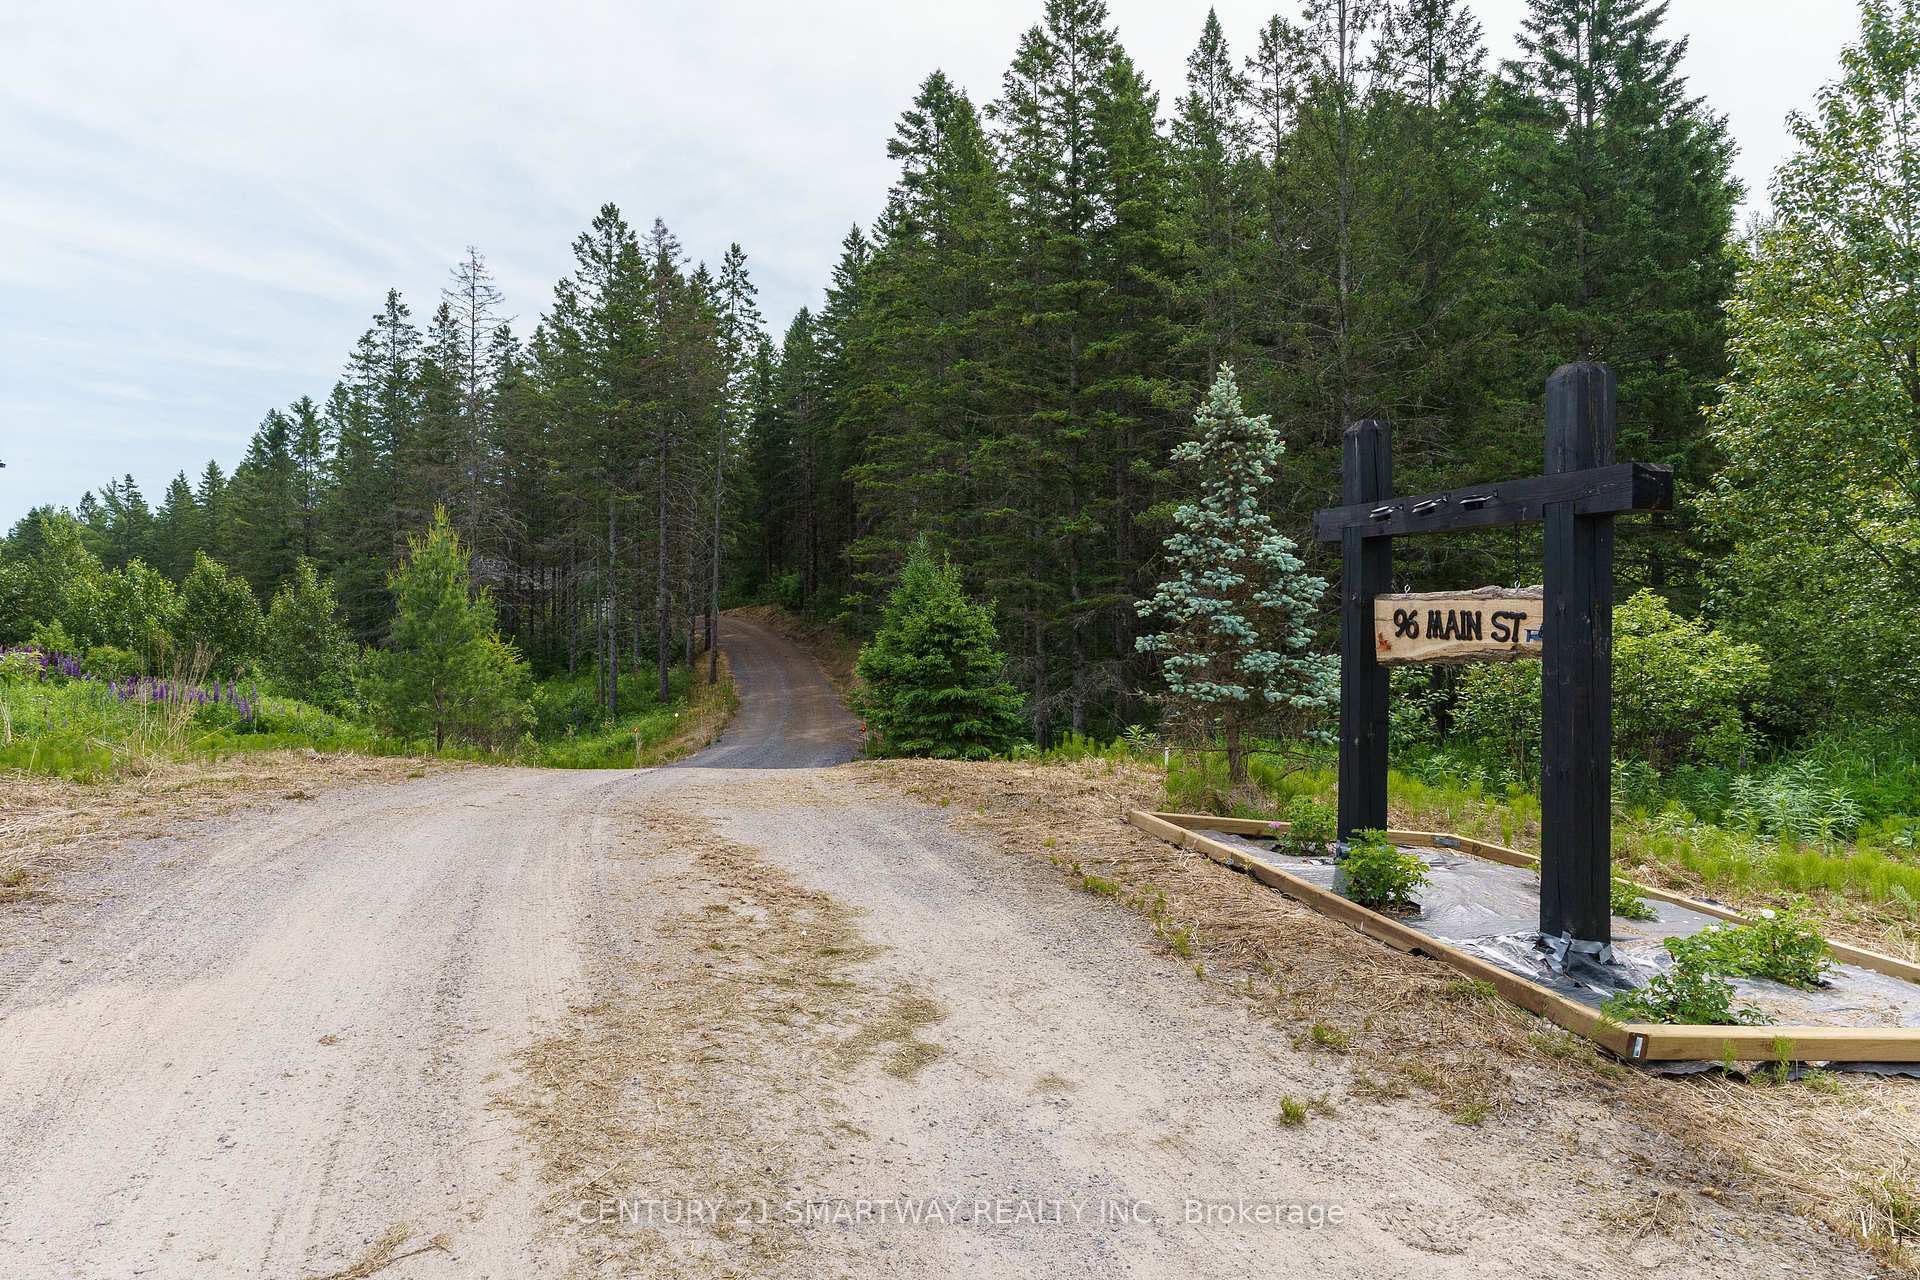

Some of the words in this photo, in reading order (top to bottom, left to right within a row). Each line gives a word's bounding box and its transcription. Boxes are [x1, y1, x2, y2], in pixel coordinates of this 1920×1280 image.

[1393, 608, 1419, 639] 96
[1425, 609, 1482, 641] MAIN
[1490, 610, 1527, 643] ST
